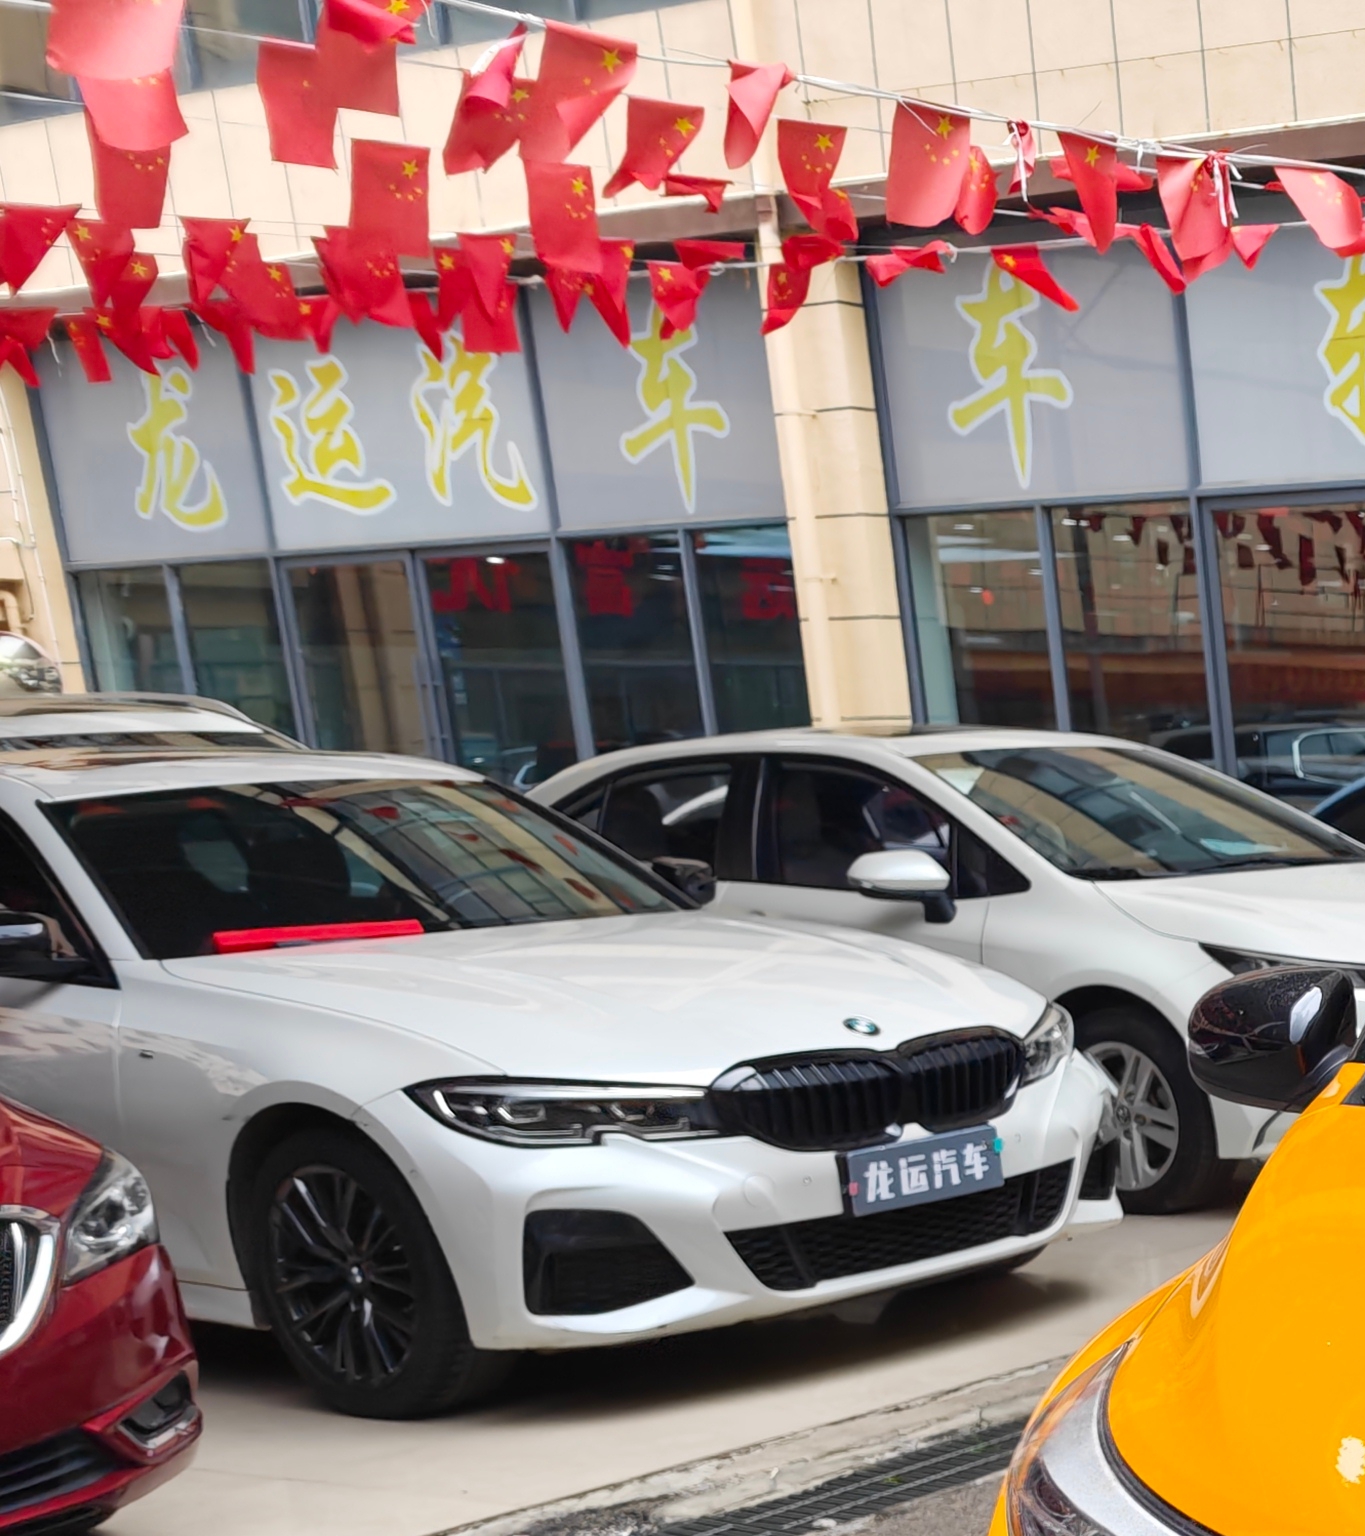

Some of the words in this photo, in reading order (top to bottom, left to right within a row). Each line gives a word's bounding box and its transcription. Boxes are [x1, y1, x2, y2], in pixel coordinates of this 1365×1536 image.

[127, 304, 731, 532] 龙运汽车
[863, 1142, 990, 1203] 龙运汽车
